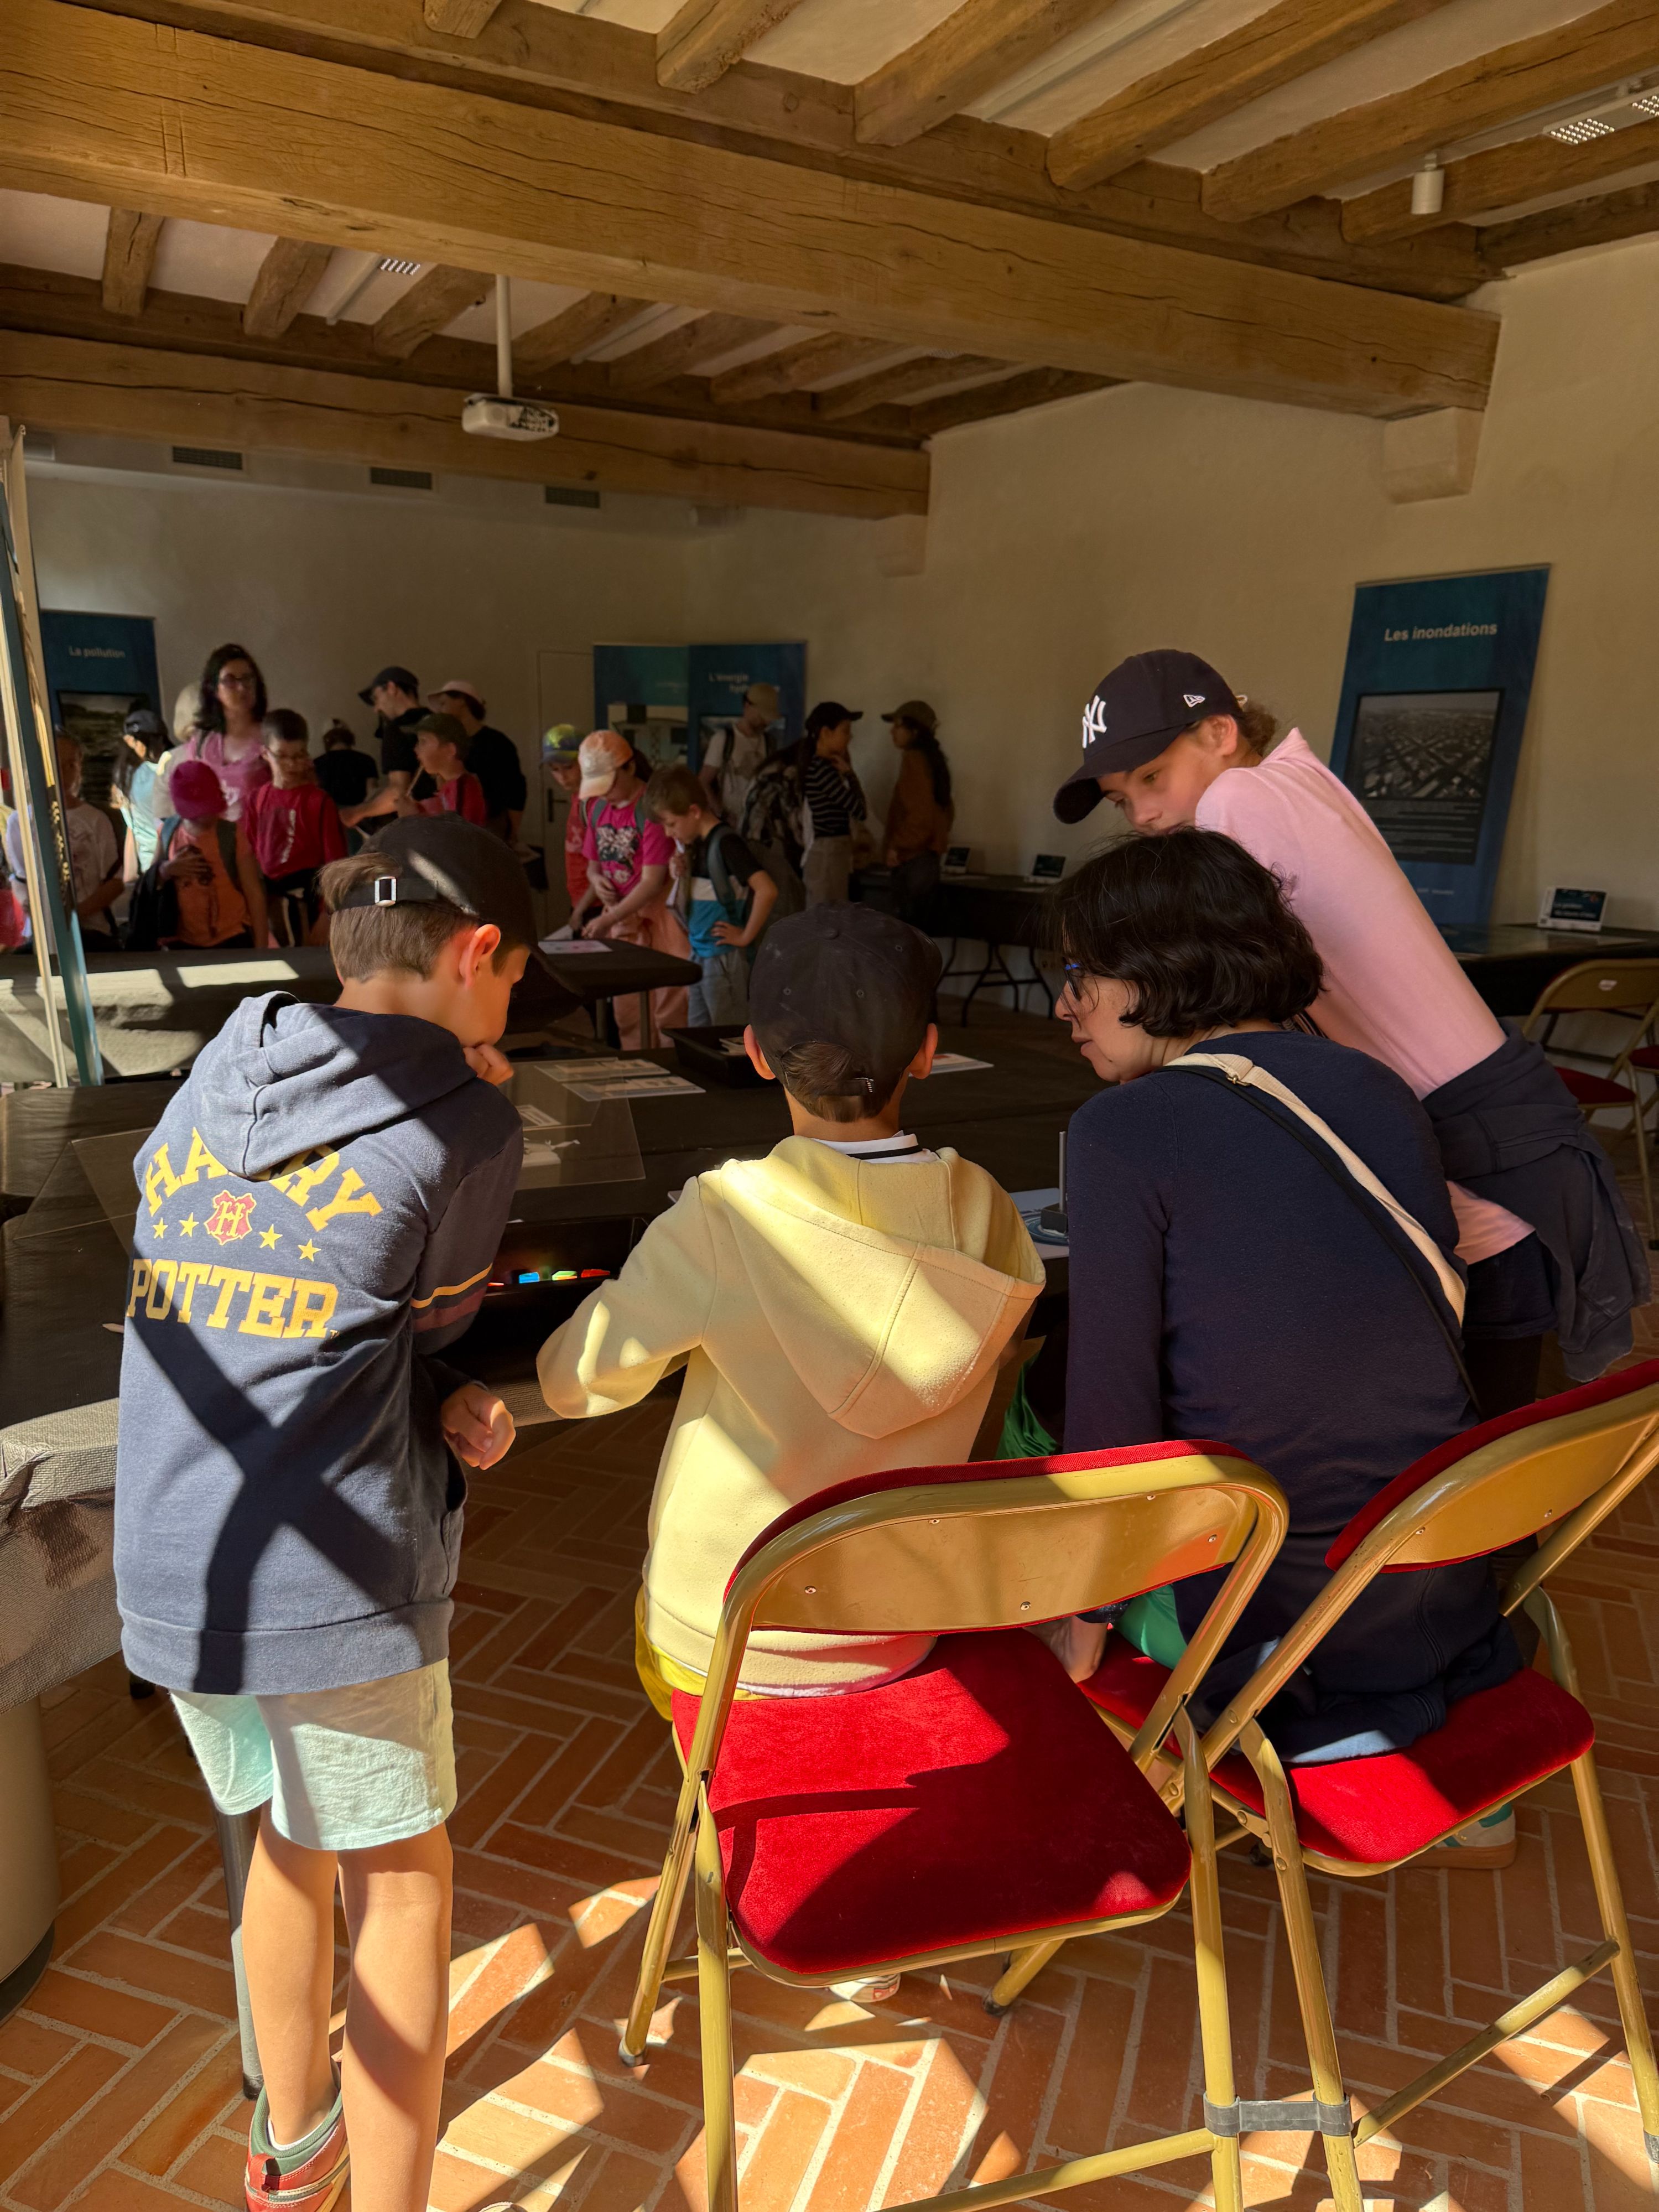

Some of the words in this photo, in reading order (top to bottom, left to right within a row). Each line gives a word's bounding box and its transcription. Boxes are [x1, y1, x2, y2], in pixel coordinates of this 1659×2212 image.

[1384, 627, 1408, 642] Les
[1412, 622, 1497, 640] inondations
[1082, 695, 1107, 749] NY
[145, 1126, 383, 1232] HARY
[126, 1258, 339, 1338] POTTER
